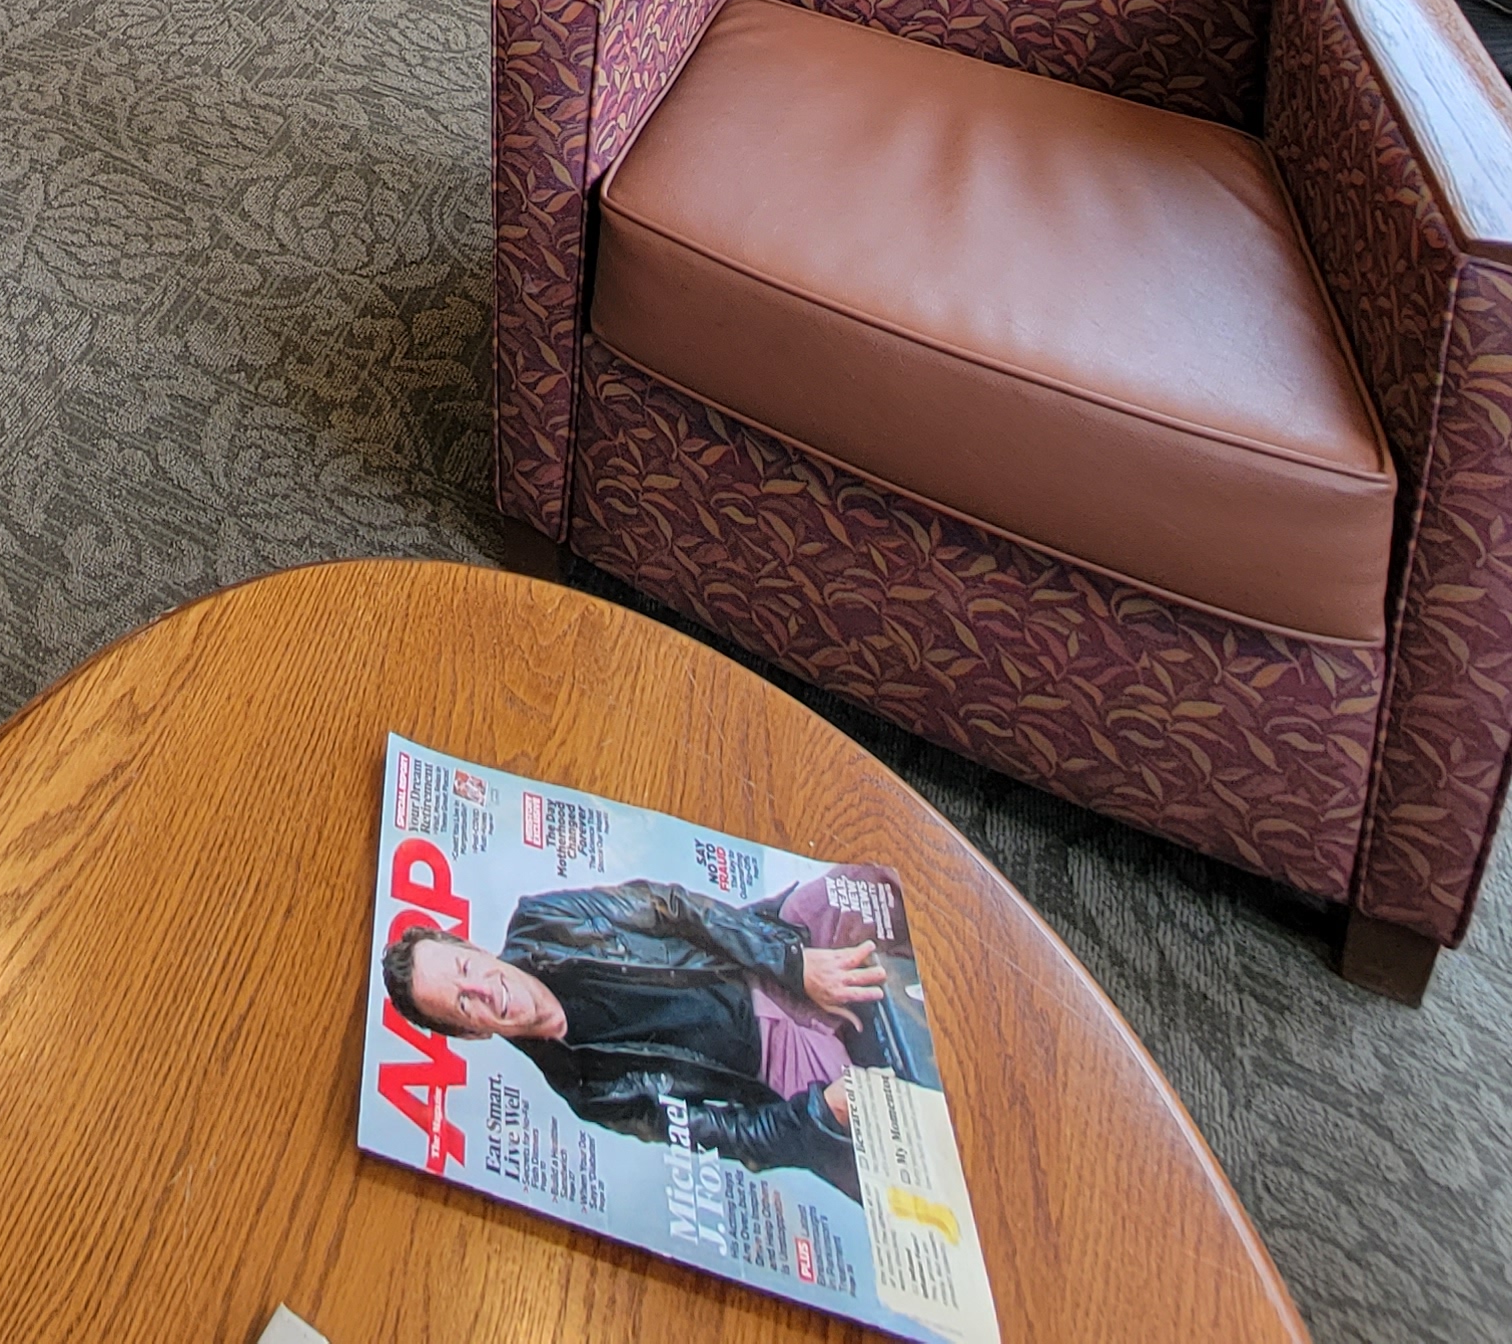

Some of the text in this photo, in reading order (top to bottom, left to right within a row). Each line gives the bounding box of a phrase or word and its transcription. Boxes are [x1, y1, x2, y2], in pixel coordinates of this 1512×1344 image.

[408, 758, 422, 832] Your Dream
[420, 762, 434, 834] Retirement
[546, 798, 557, 847] The Day
[555, 802, 567, 879] Motherhood
[565, 803, 578, 860] Changed
[576, 805, 588, 856] Forever
[694, 838, 707, 867] SAY
[705, 843, 719, 884] NO TO
[716, 847, 731, 893] FRAUD
[485, 1073, 503, 1175] Eat Smart,
[503, 1085, 520, 1182] Live Well
[657, 1093, 698, 1245] Michael
[693, 1142, 726, 1218] Fox
[895, 1146, 908, 1165] My
[797, 1240, 812, 1278] PLUS
